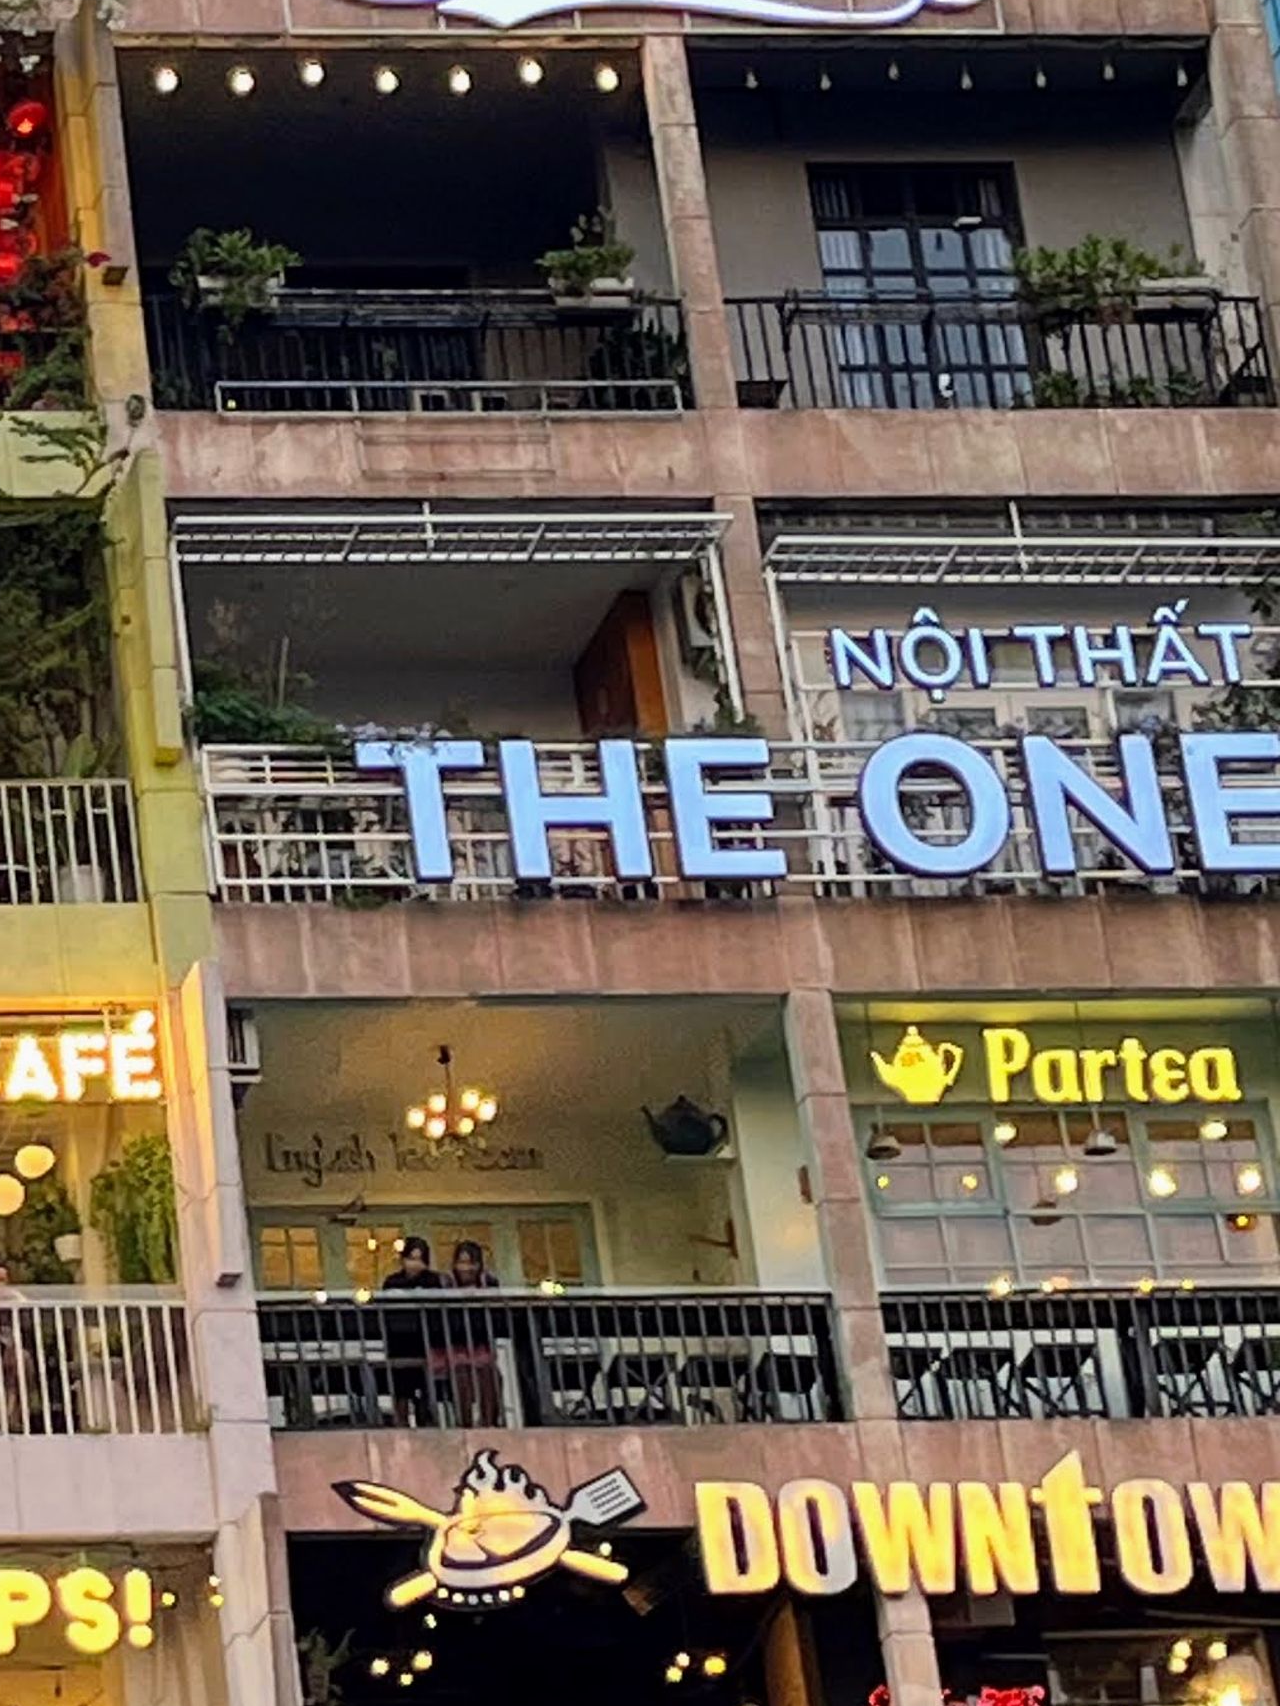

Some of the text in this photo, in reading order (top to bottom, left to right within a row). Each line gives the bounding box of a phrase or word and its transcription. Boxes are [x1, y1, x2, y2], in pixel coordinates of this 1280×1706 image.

[829, 600, 1254, 702] NỘI THẤT
[354, 729, 1280, 884] THE ONE
